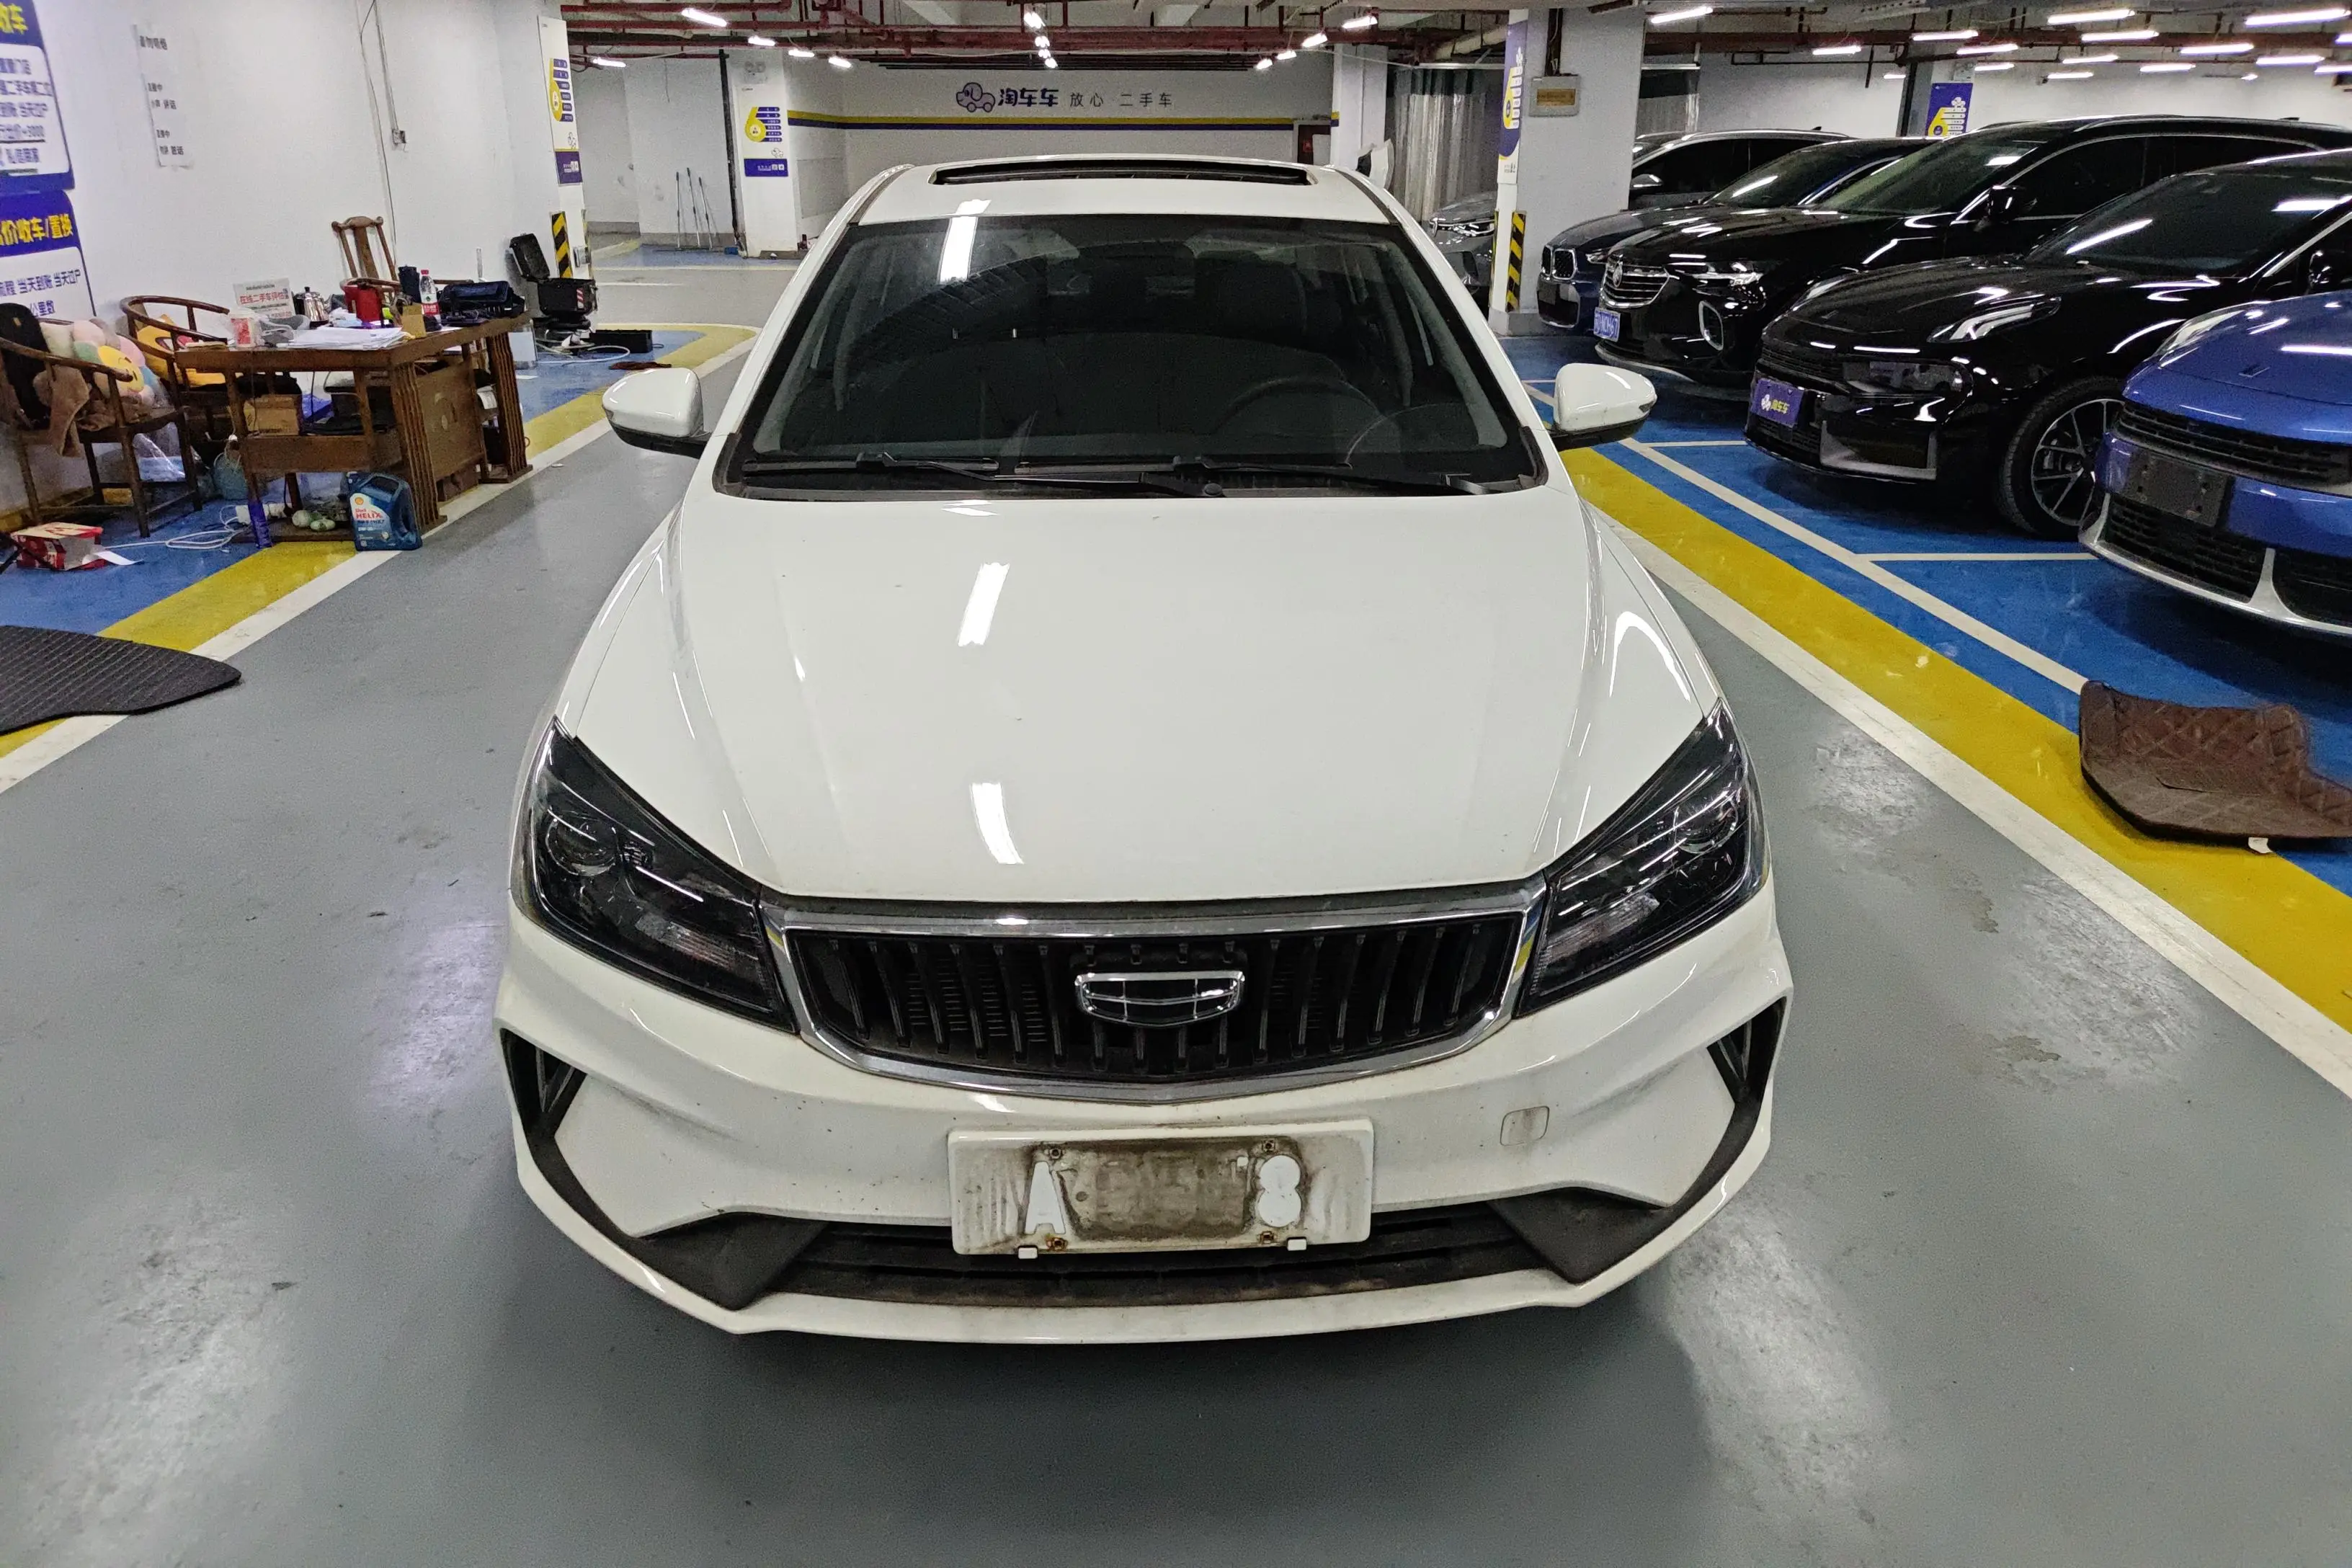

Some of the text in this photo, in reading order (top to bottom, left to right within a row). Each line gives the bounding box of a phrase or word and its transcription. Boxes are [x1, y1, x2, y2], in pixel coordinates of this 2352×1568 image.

[998, 88, 1172, 107] 淘车车 放心 二手车
[17, 275, 53, 293] 当天到账
[54, 269, 81, 288] 当天过户
